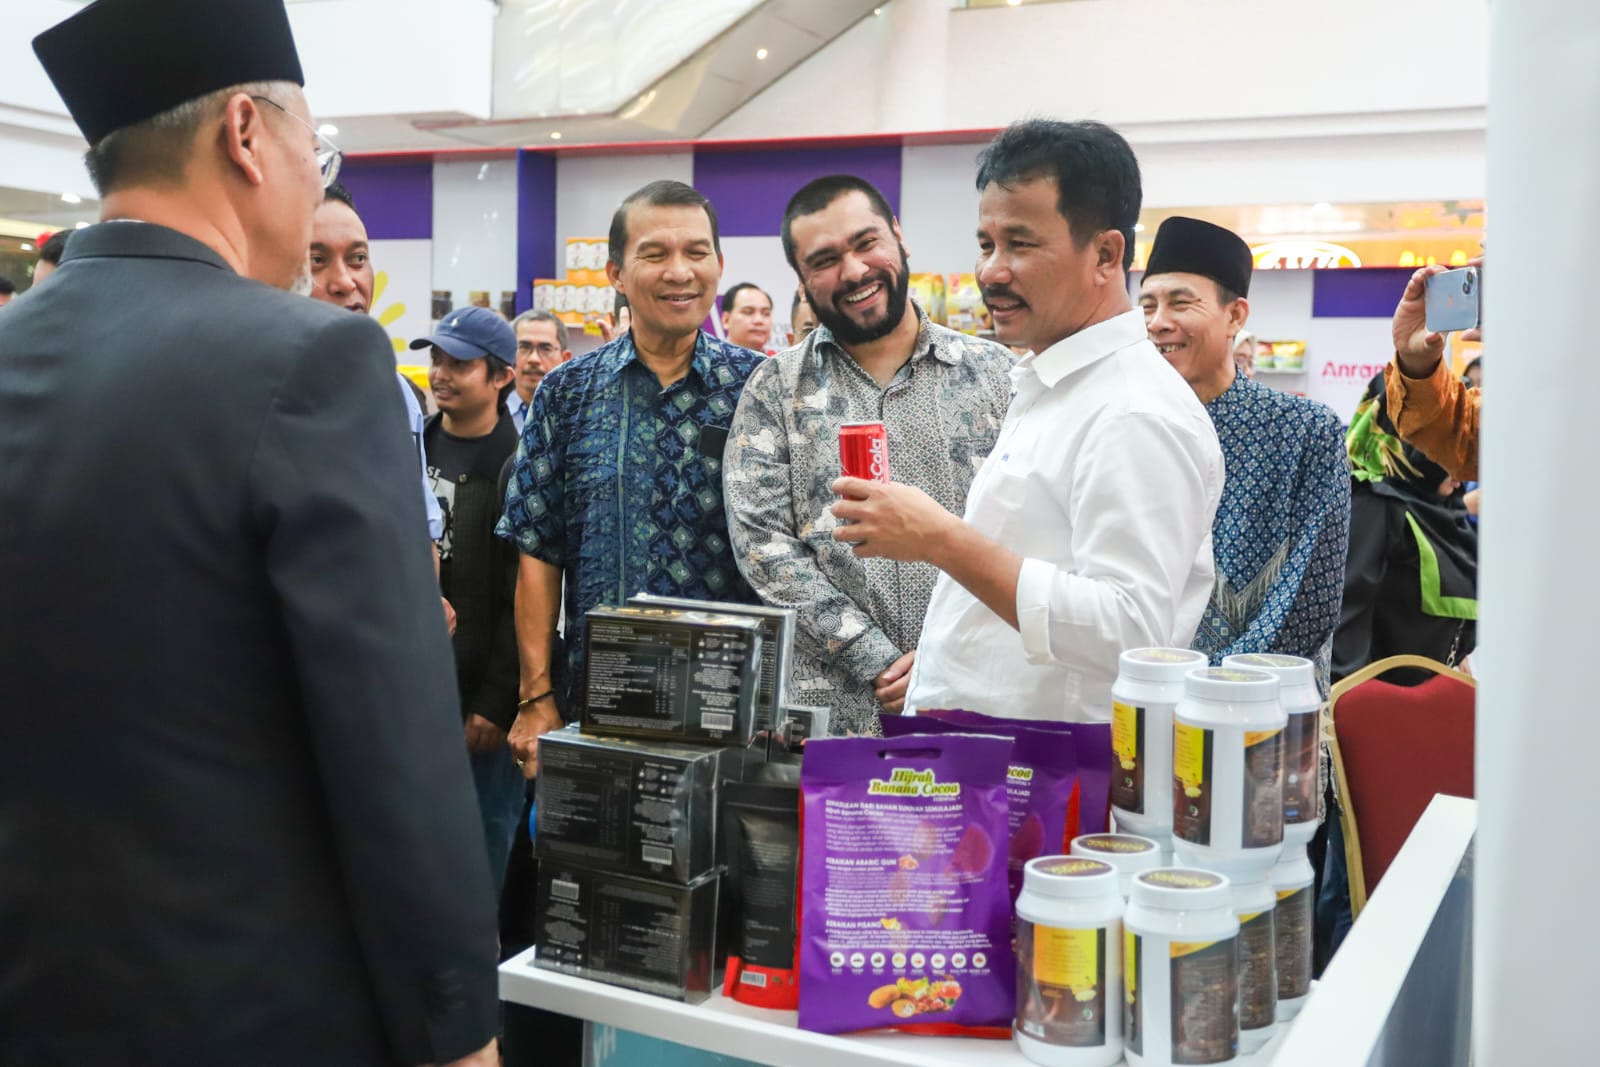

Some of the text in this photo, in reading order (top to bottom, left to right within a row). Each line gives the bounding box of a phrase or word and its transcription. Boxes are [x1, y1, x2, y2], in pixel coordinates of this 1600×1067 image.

[869, 438, 883, 477] Cola
[891, 769, 934, 785] Hijrah
[869, 780, 960, 796] Banana Cocoa
